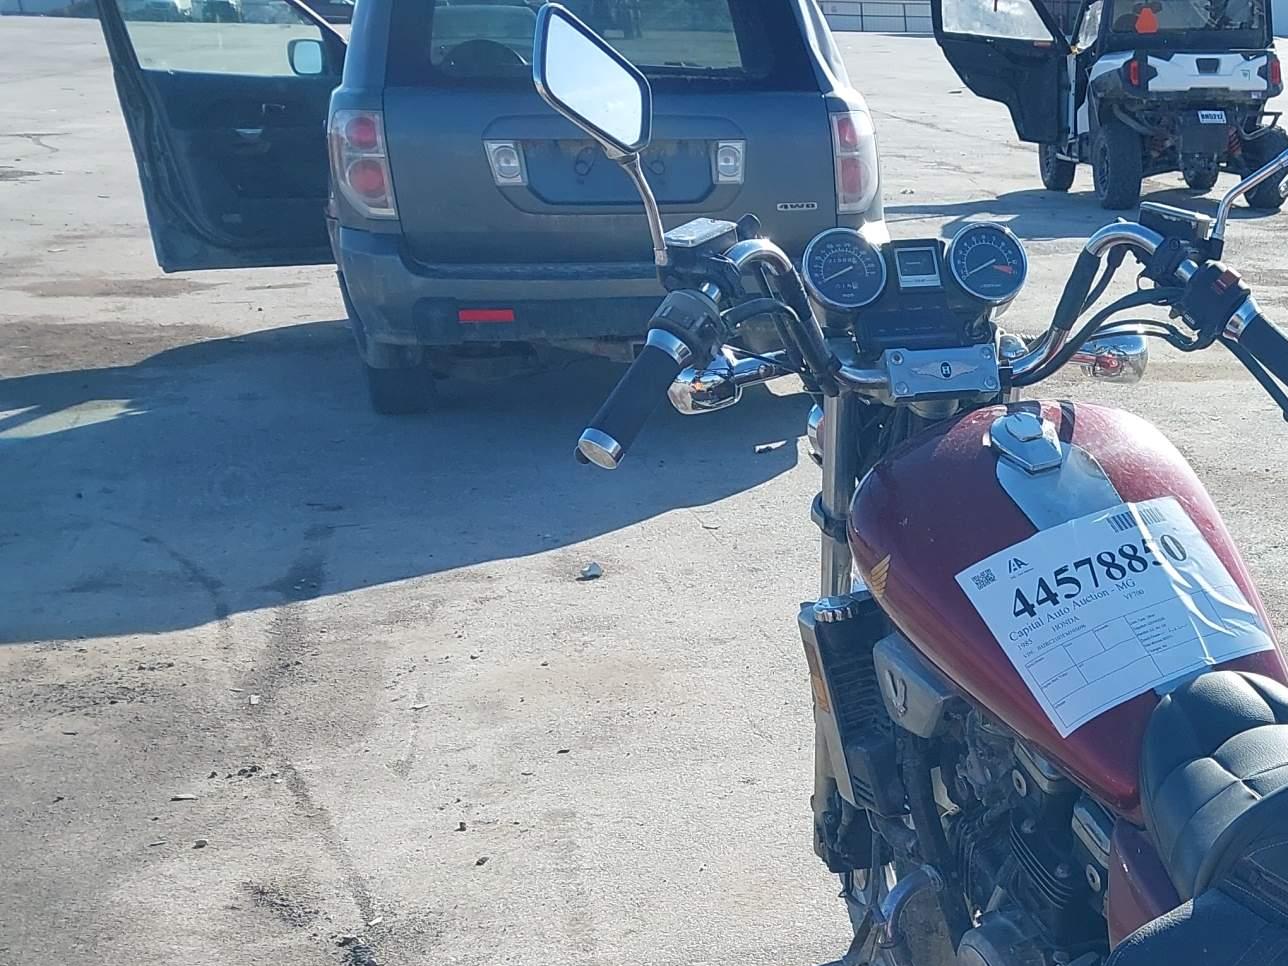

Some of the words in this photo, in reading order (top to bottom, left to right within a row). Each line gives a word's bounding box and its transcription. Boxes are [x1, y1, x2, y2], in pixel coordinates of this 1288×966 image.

[1009, 617, 1044, 642] Capital
[1046, 605, 1070, 623] Auto
[1073, 589, 1110, 609] Auction
[1115, 580, 1136, 595] MG
[1017, 639, 1033, 650] 1985
[1051, 615, 1080, 632] HONDA
